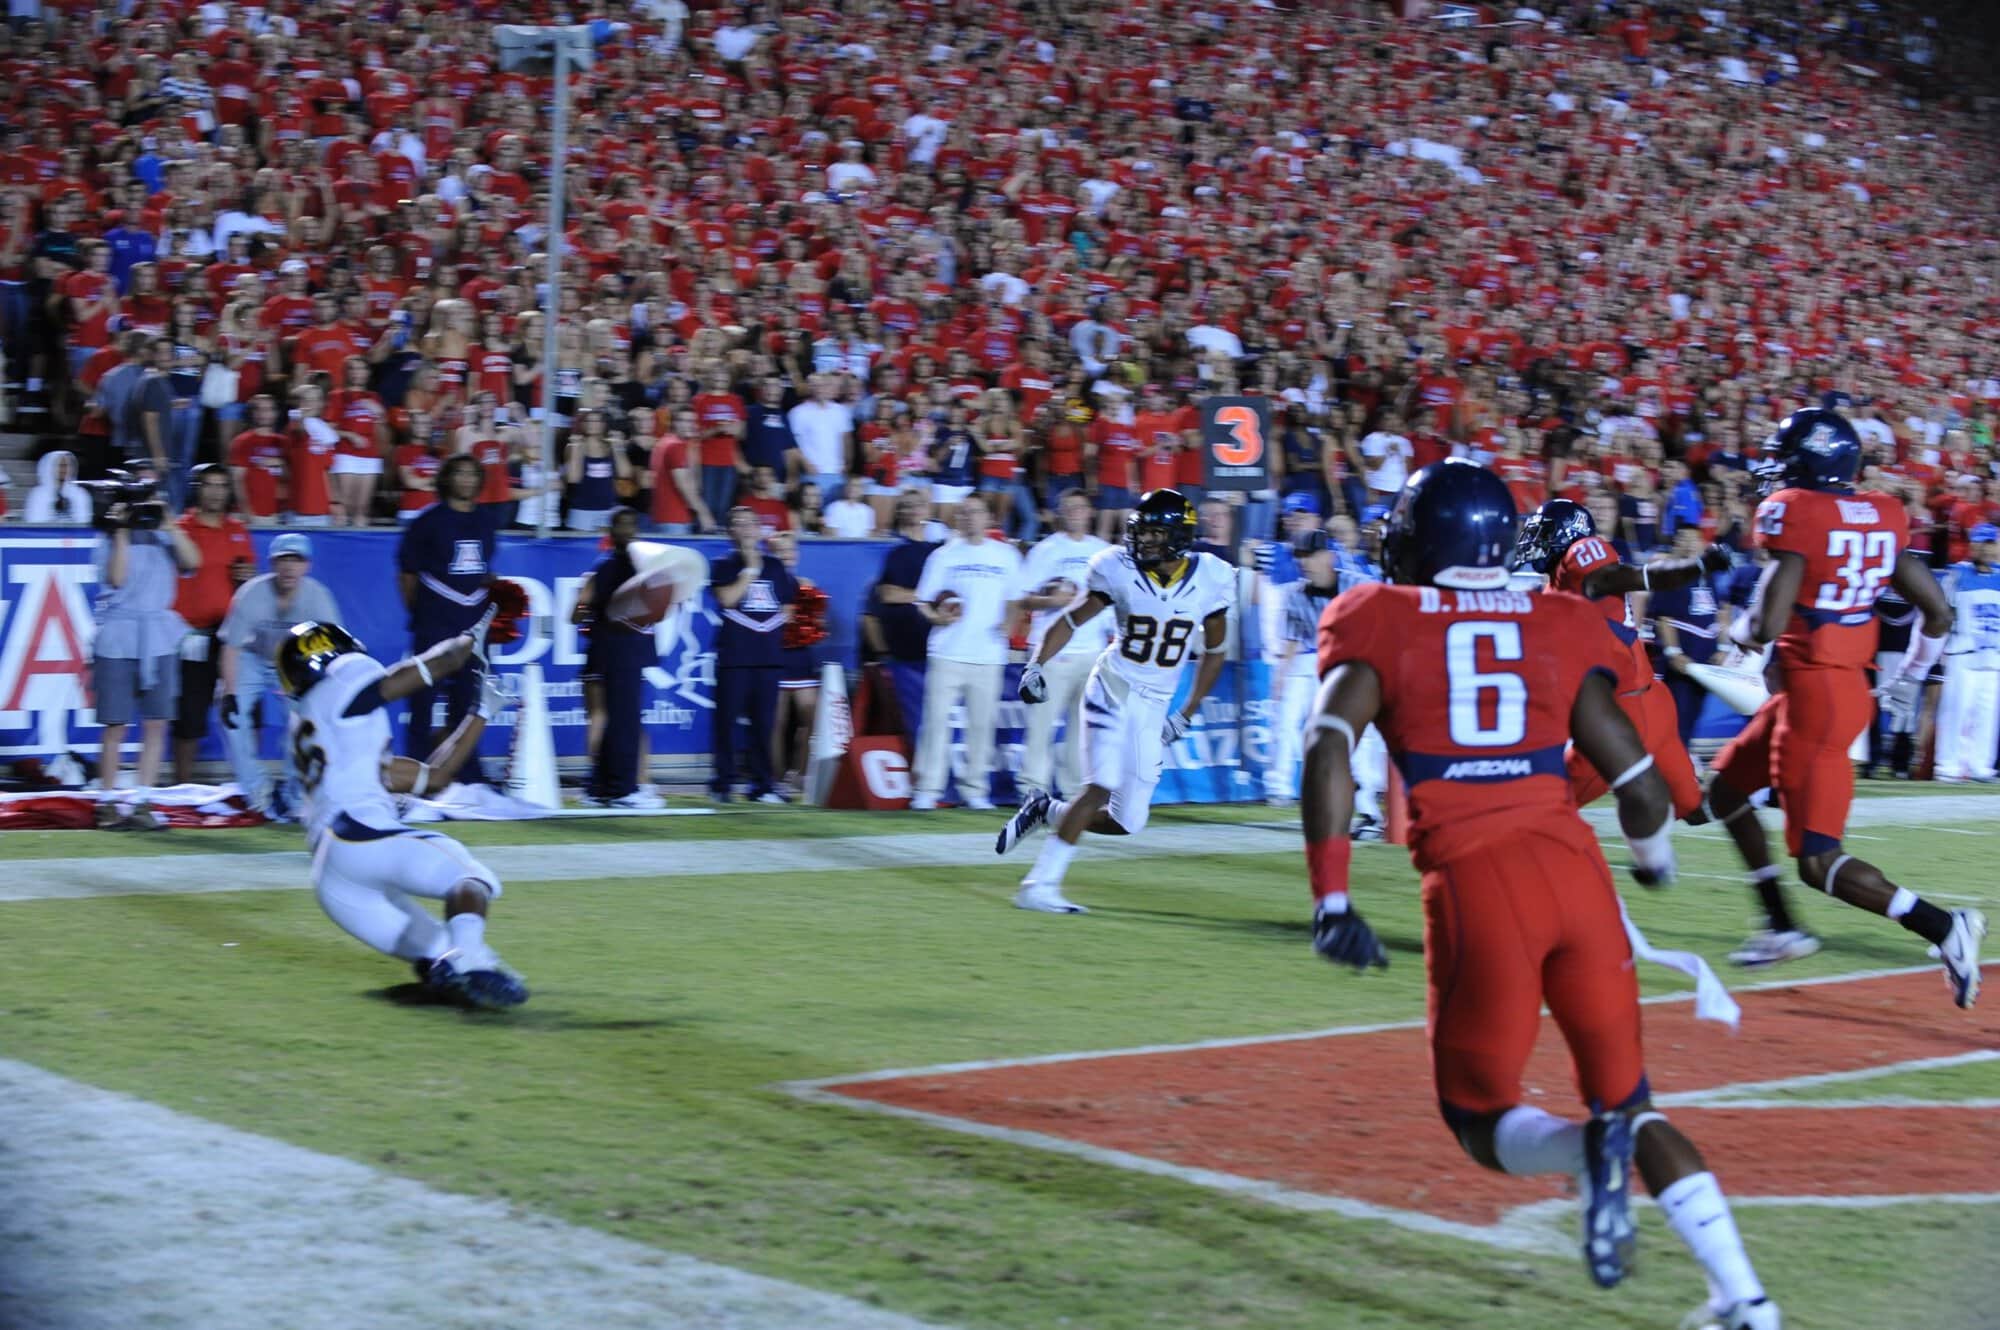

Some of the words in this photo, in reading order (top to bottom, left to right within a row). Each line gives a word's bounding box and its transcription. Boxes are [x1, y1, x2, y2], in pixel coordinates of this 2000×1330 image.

[1212, 405, 1264, 466] 3
[1574, 539, 1608, 569] 20
[1814, 529, 1898, 611] 32
[1418, 585, 1452, 614] D.
[1120, 614, 1195, 669] 88
[1446, 620, 1528, 747] 6
[860, 749, 913, 800] G
[1442, 758, 1533, 780] ARIZONA
